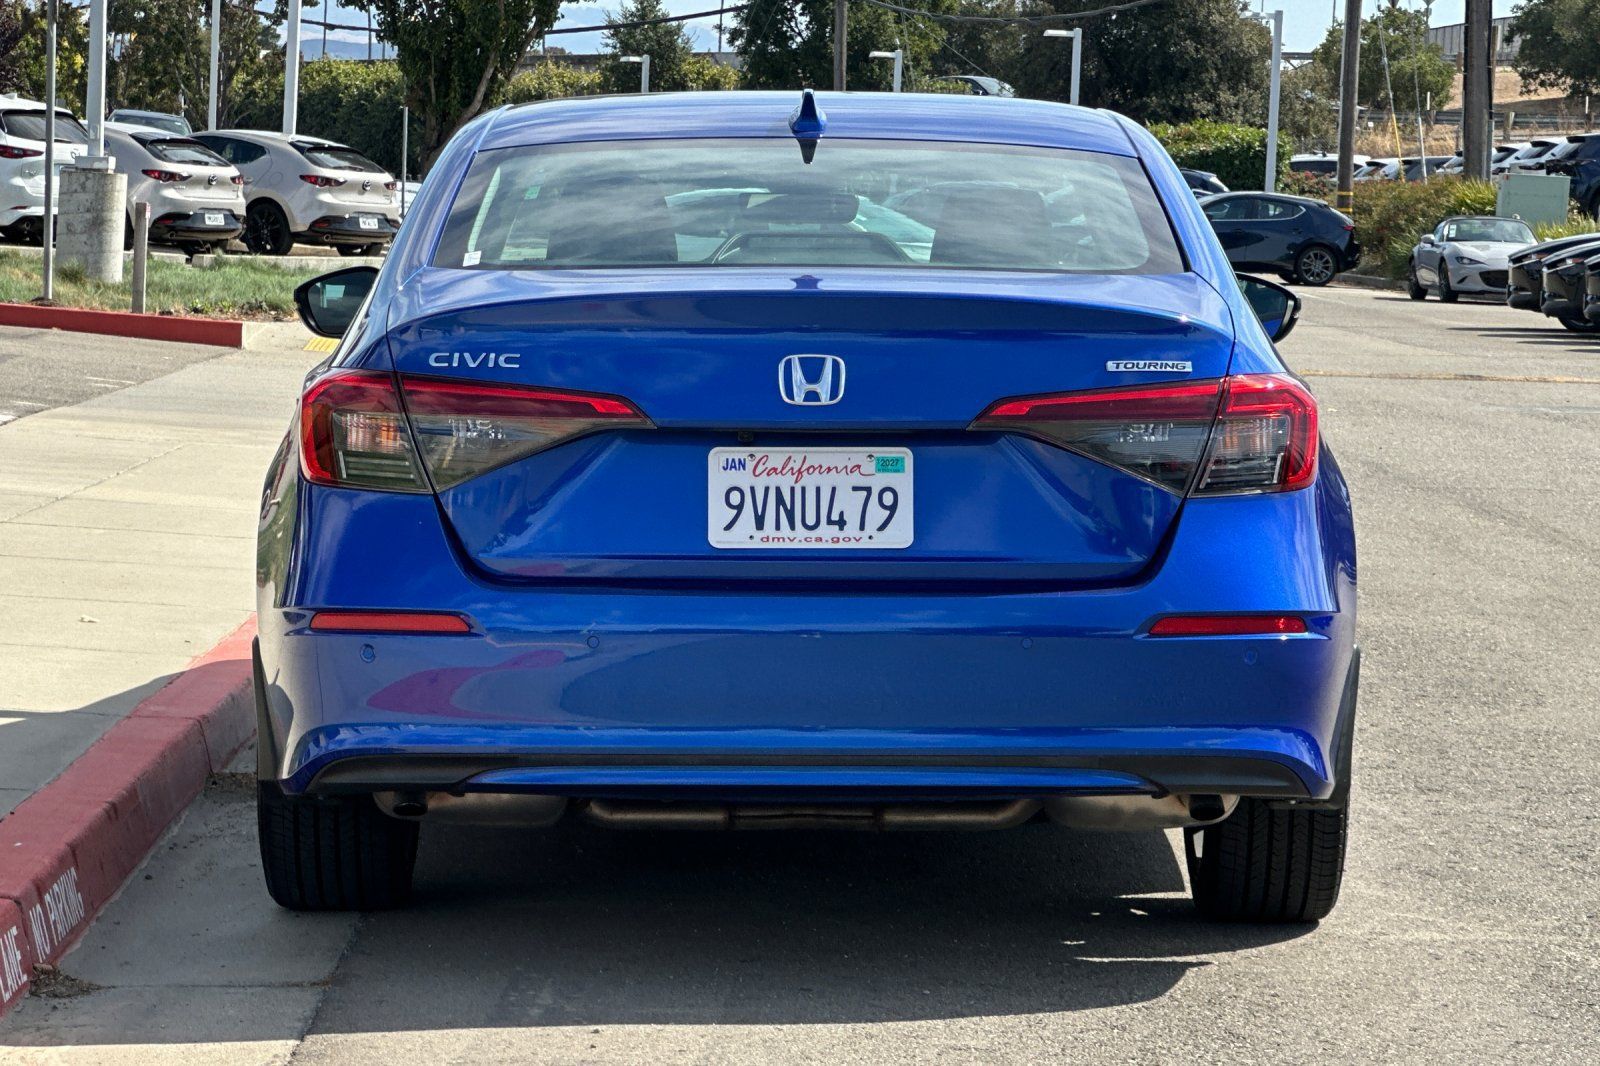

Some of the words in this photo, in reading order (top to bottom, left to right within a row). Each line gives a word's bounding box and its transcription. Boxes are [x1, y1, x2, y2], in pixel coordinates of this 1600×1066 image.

[428, 352, 520, 368] CIVIC
[1111, 361, 1187, 371] TOURING
[722, 457, 746, 471] JAN
[752, 454, 876, 484] California
[880, 459, 900, 467] 2027
[723, 486, 899, 531] 9VNU479
[760, 535, 863, 543] dmv.ca.gov
[29, 903, 51, 963] NO
[44, 866, 85, 946] PARKING
